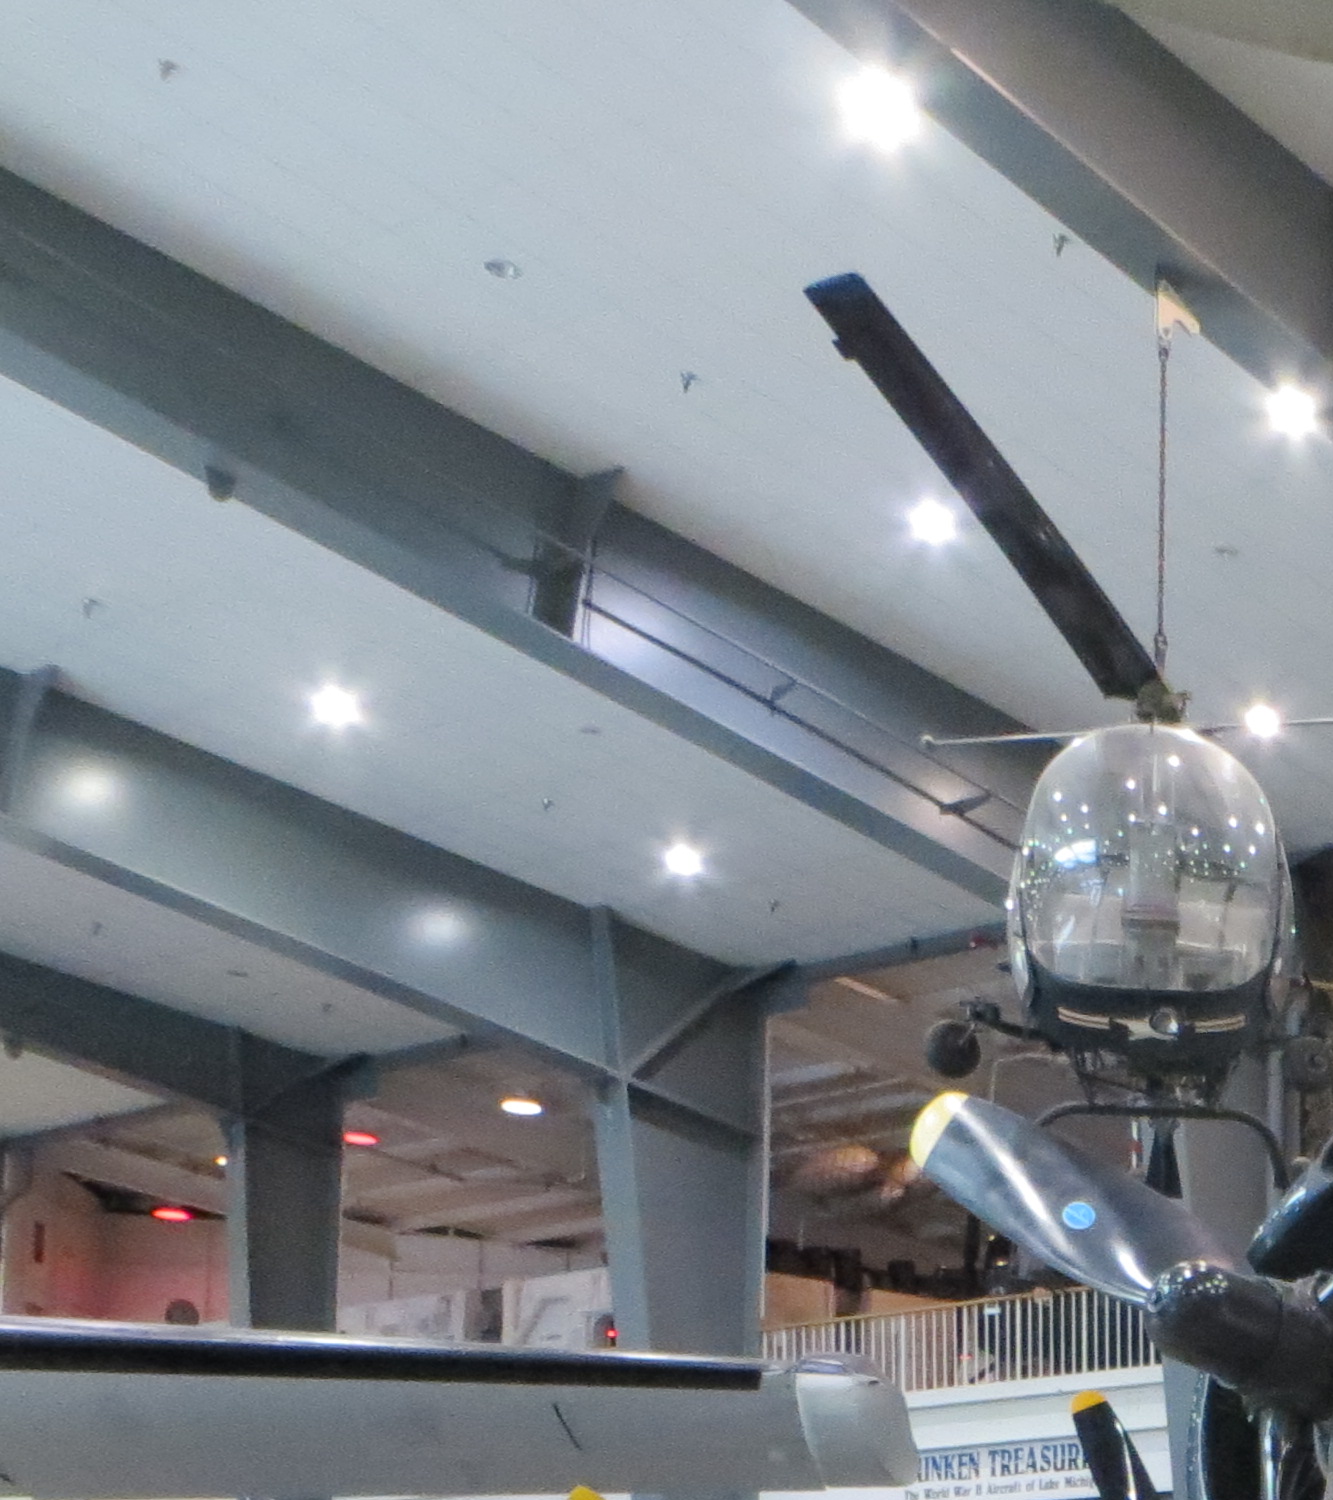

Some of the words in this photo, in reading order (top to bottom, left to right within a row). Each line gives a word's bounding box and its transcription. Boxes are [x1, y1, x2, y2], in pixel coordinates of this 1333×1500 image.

[917, 1452, 980, 1482] UNKEN
[924, 1487, 950, 1500] World
[954, 1485, 972, 1498] War
[987, 1480, 1021, 1496] Aircraft
[1026, 1479, 1035, 1492] of
[1039, 1478, 1060, 1491] Lake
